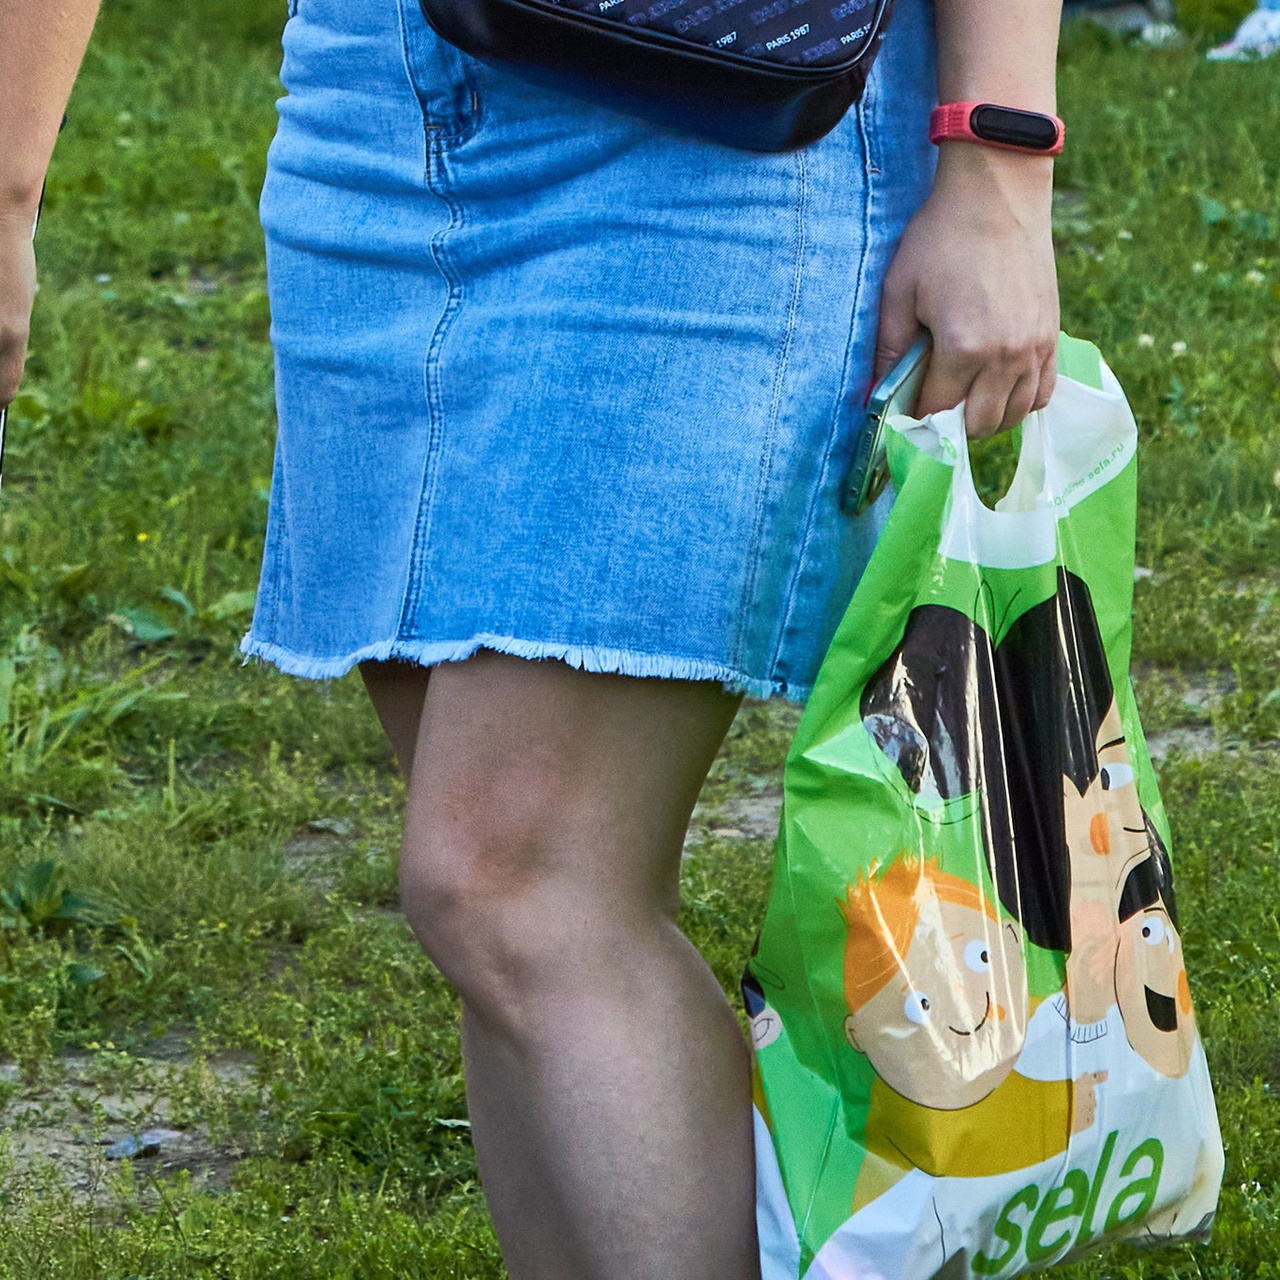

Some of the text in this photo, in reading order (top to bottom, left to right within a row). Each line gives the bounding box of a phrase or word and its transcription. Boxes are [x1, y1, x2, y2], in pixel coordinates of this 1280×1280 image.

[716, 32, 737, 48] 1987
[766, 35, 790, 51] PARIS
[789, 24, 810, 41] 1987
[840, 28, 862, 45] PARIS
[971, 1130, 1164, 1276] sela
